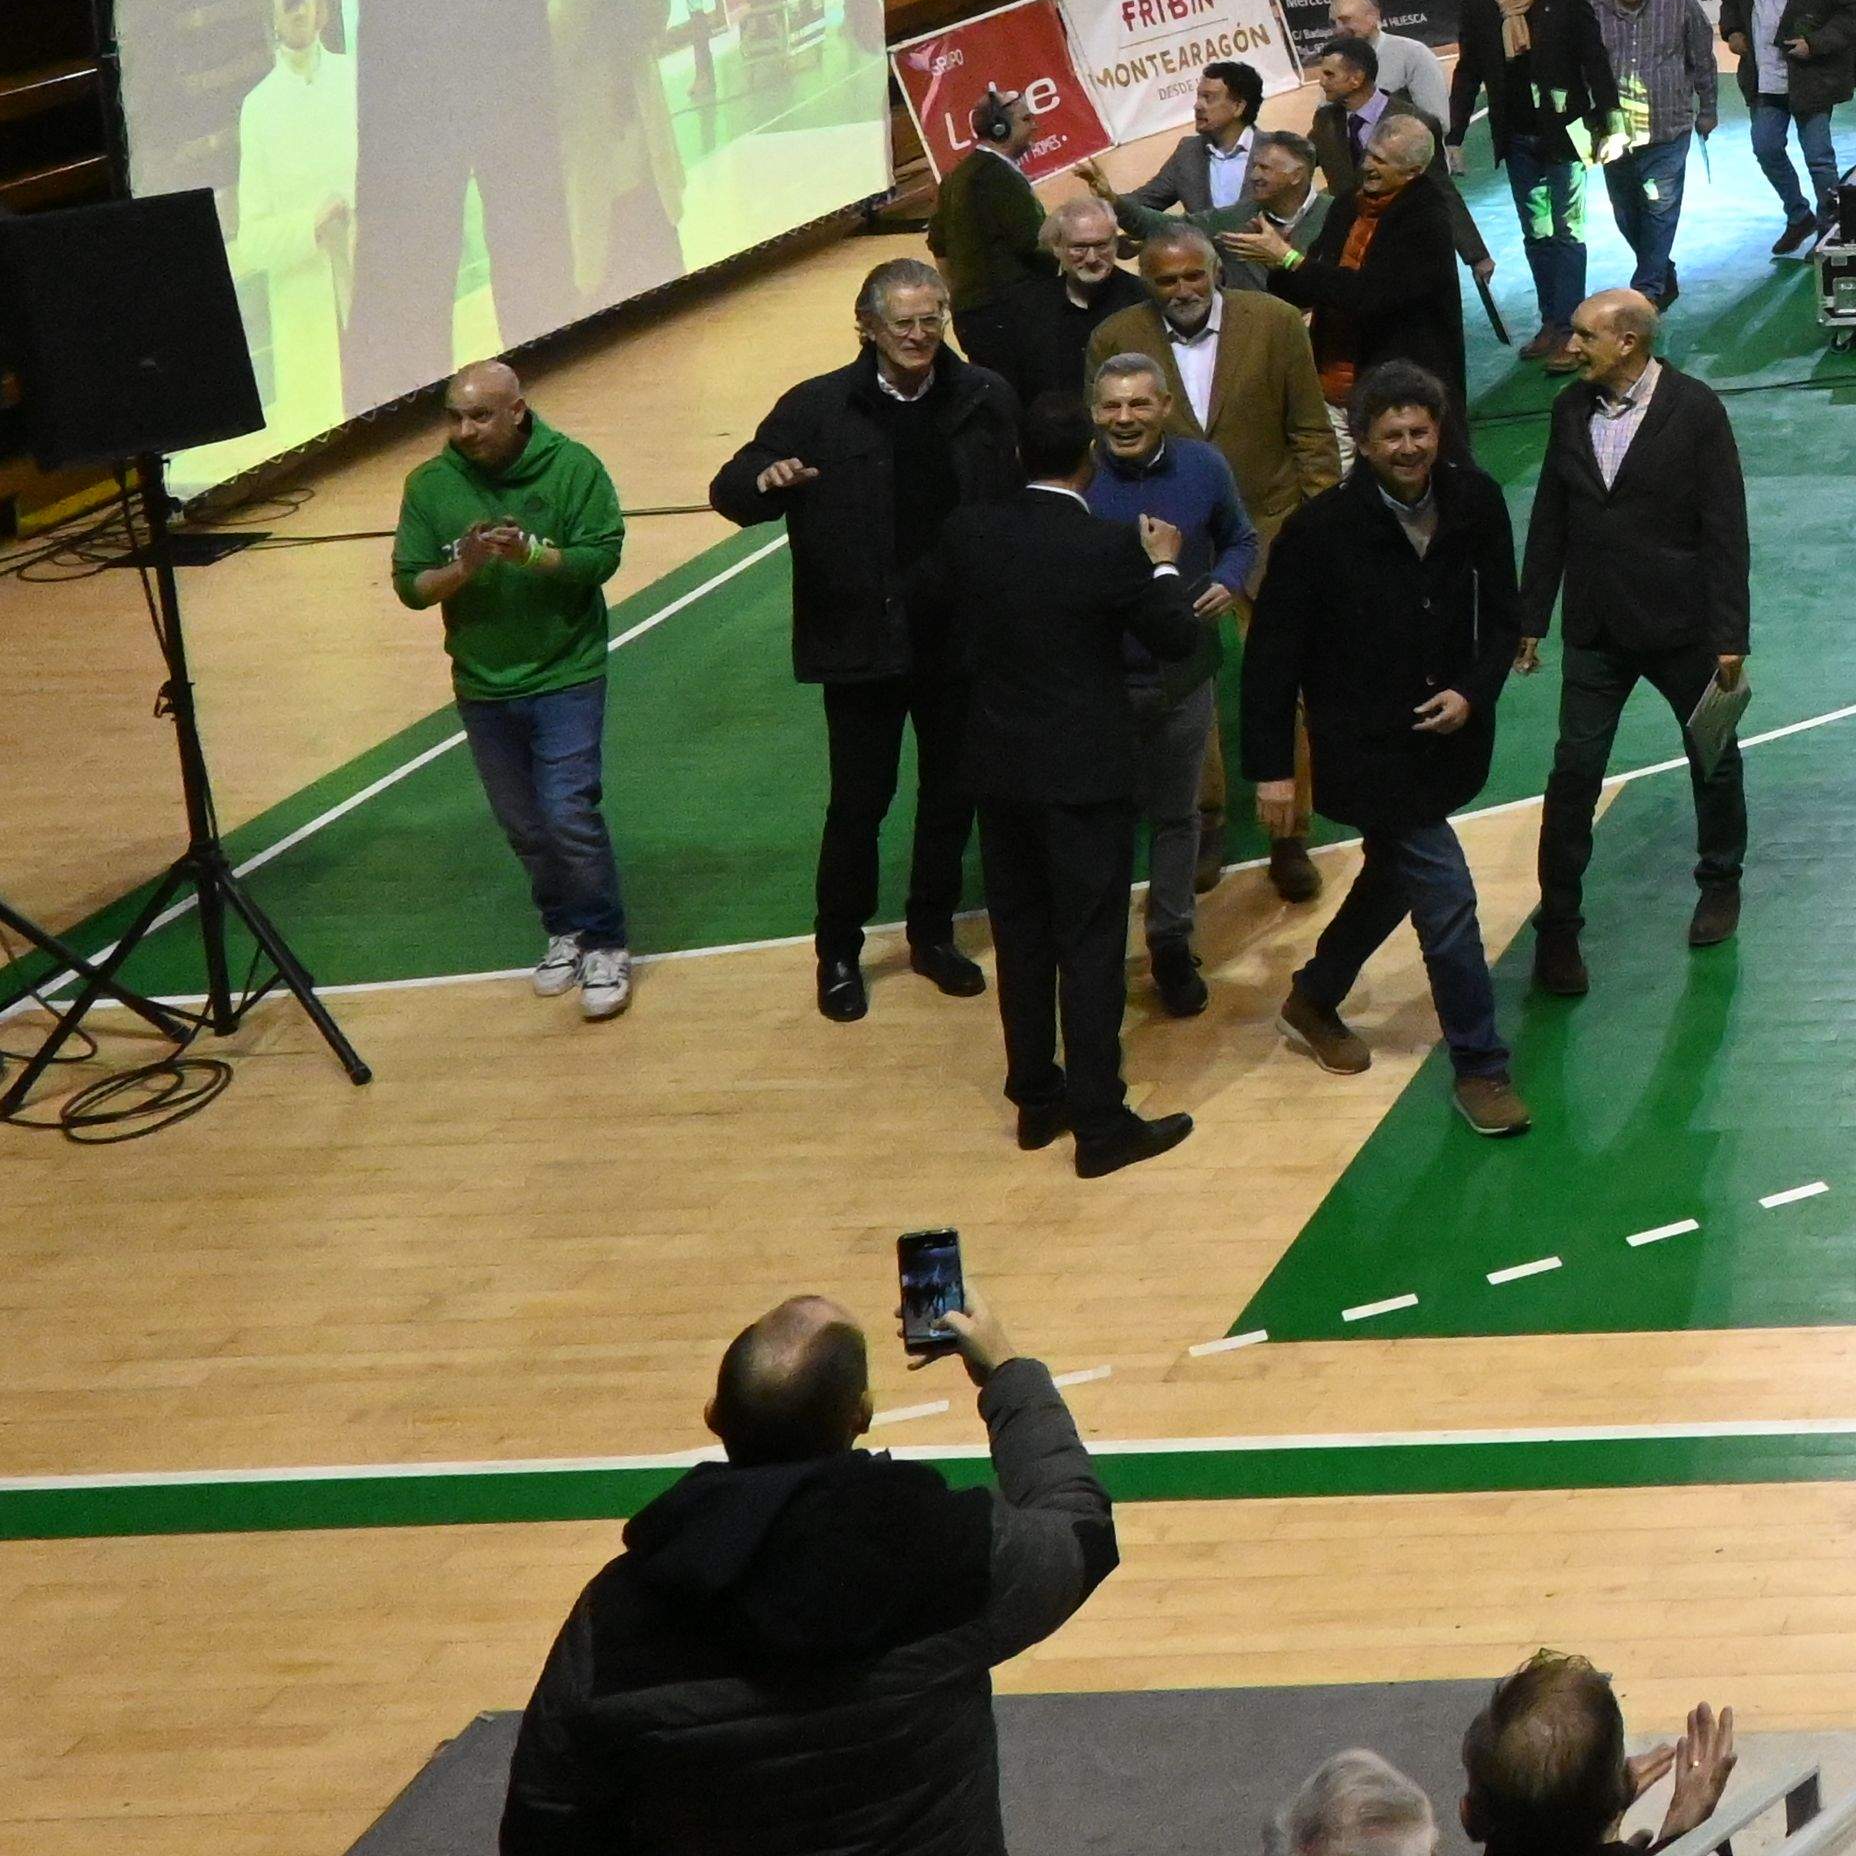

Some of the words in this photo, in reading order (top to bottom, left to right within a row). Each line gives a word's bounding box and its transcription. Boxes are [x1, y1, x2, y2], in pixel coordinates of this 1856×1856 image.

[1388, 12, 1429, 28] HUESCA
[1088, 22, 1272, 91] MONTEARAGÓN
[1158, 80, 1193, 101] DESDE
